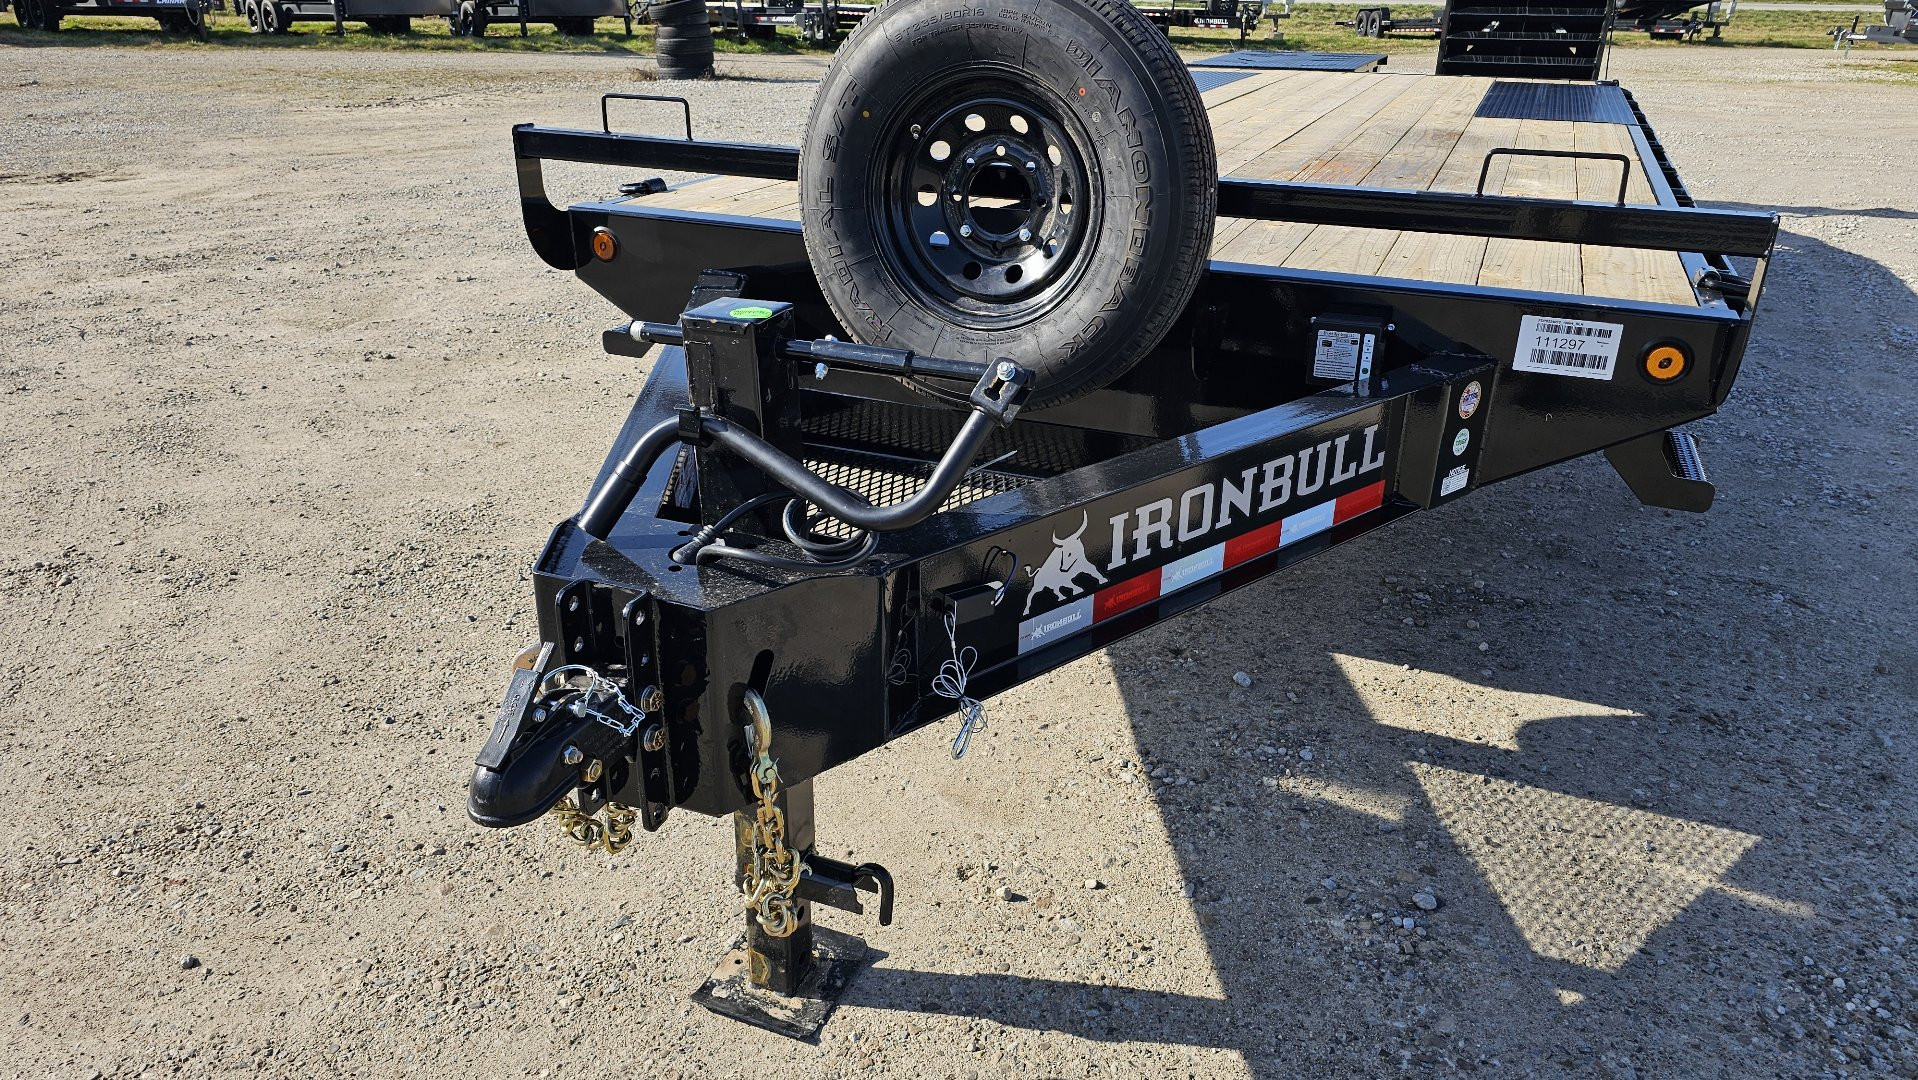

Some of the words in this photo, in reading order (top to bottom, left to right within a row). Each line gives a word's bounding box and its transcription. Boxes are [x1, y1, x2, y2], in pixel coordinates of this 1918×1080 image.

[911, 35, 927, 46] FOR
[929, 24, 962, 39] TRAILER
[965, 22, 998, 30] SERVICE
[1001, 25, 1023, 34] ONLY
[822, 79, 859, 163] S/T
[819, 176, 892, 342] RADIAL
[1536, 336, 1585, 350] 111297
[1107, 424, 1385, 570] IRONBULL
[1043, 609, 1082, 632] IRONBULL
